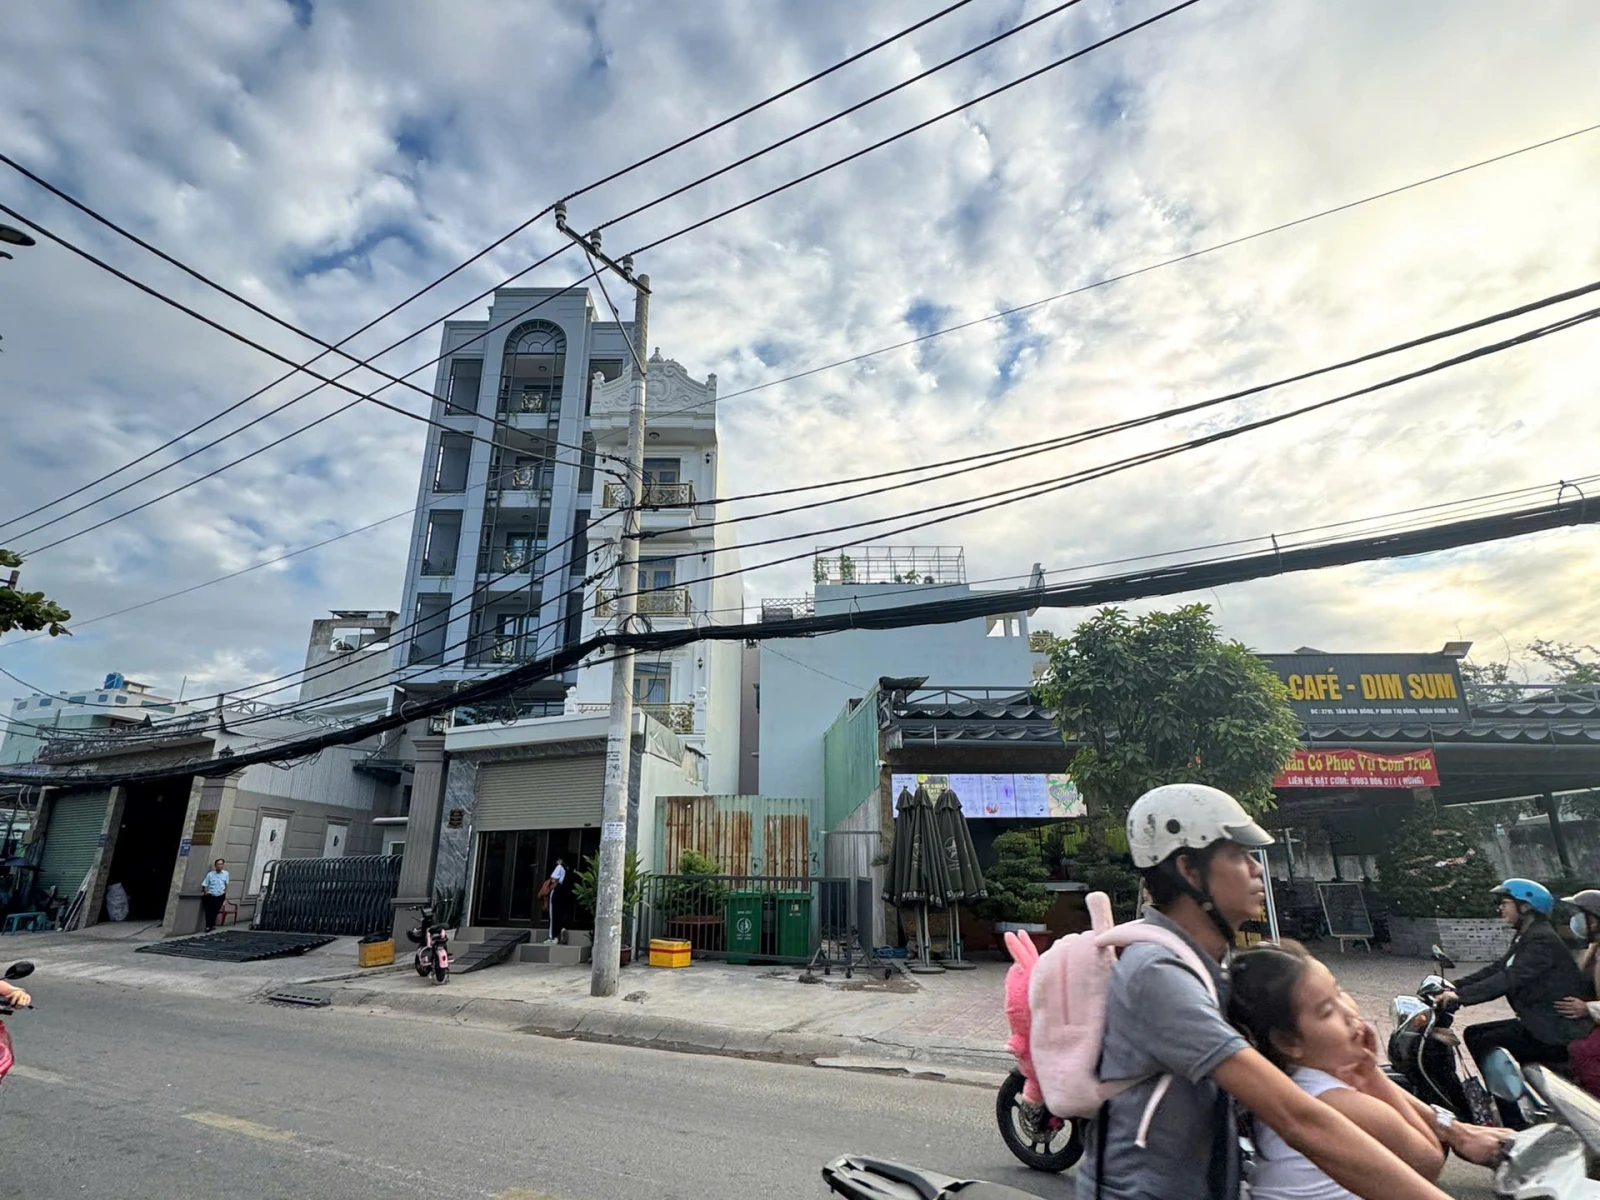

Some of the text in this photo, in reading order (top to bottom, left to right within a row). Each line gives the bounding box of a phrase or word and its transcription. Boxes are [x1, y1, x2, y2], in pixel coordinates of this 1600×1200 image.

[1288, 667, 1342, 700] CAFÉ
[1360, 673, 1404, 701] DIM
[1407, 673, 1458, 701] SUM
[1279, 757, 1305, 774] uán
[1308, 754, 1323, 771] Có
[1326, 754, 1355, 776] Phục
[1357, 753, 1376, 776] Vụ
[1288, 775, 1304, 785] LIÊN
